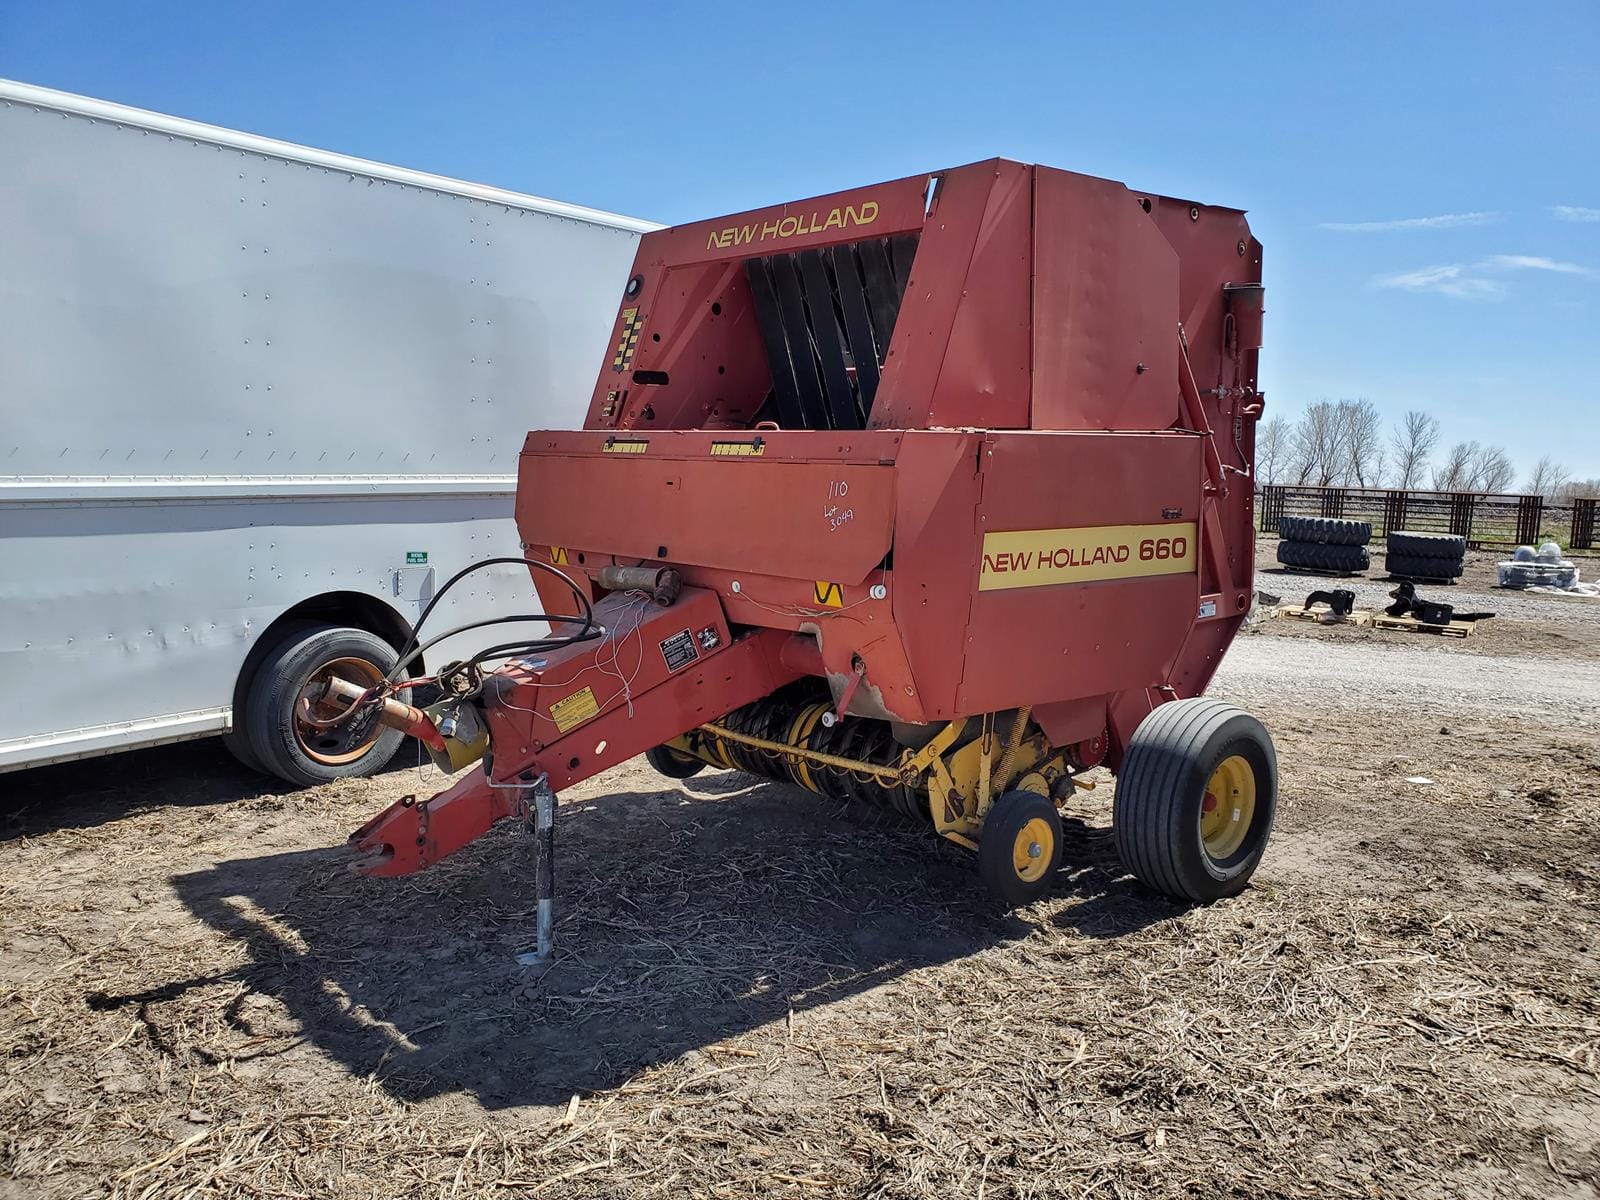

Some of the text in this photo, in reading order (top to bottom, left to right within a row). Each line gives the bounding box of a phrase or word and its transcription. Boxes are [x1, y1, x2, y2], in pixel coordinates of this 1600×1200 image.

[706, 201, 879, 250] NEW HOLLAND
[828, 480, 848, 500] 110
[823, 504, 838, 518] Lot
[830, 509, 854, 531] 3049
[982, 537, 1187, 573] NEW HOLLAND 660
[561, 689, 586, 704] CAUTION
